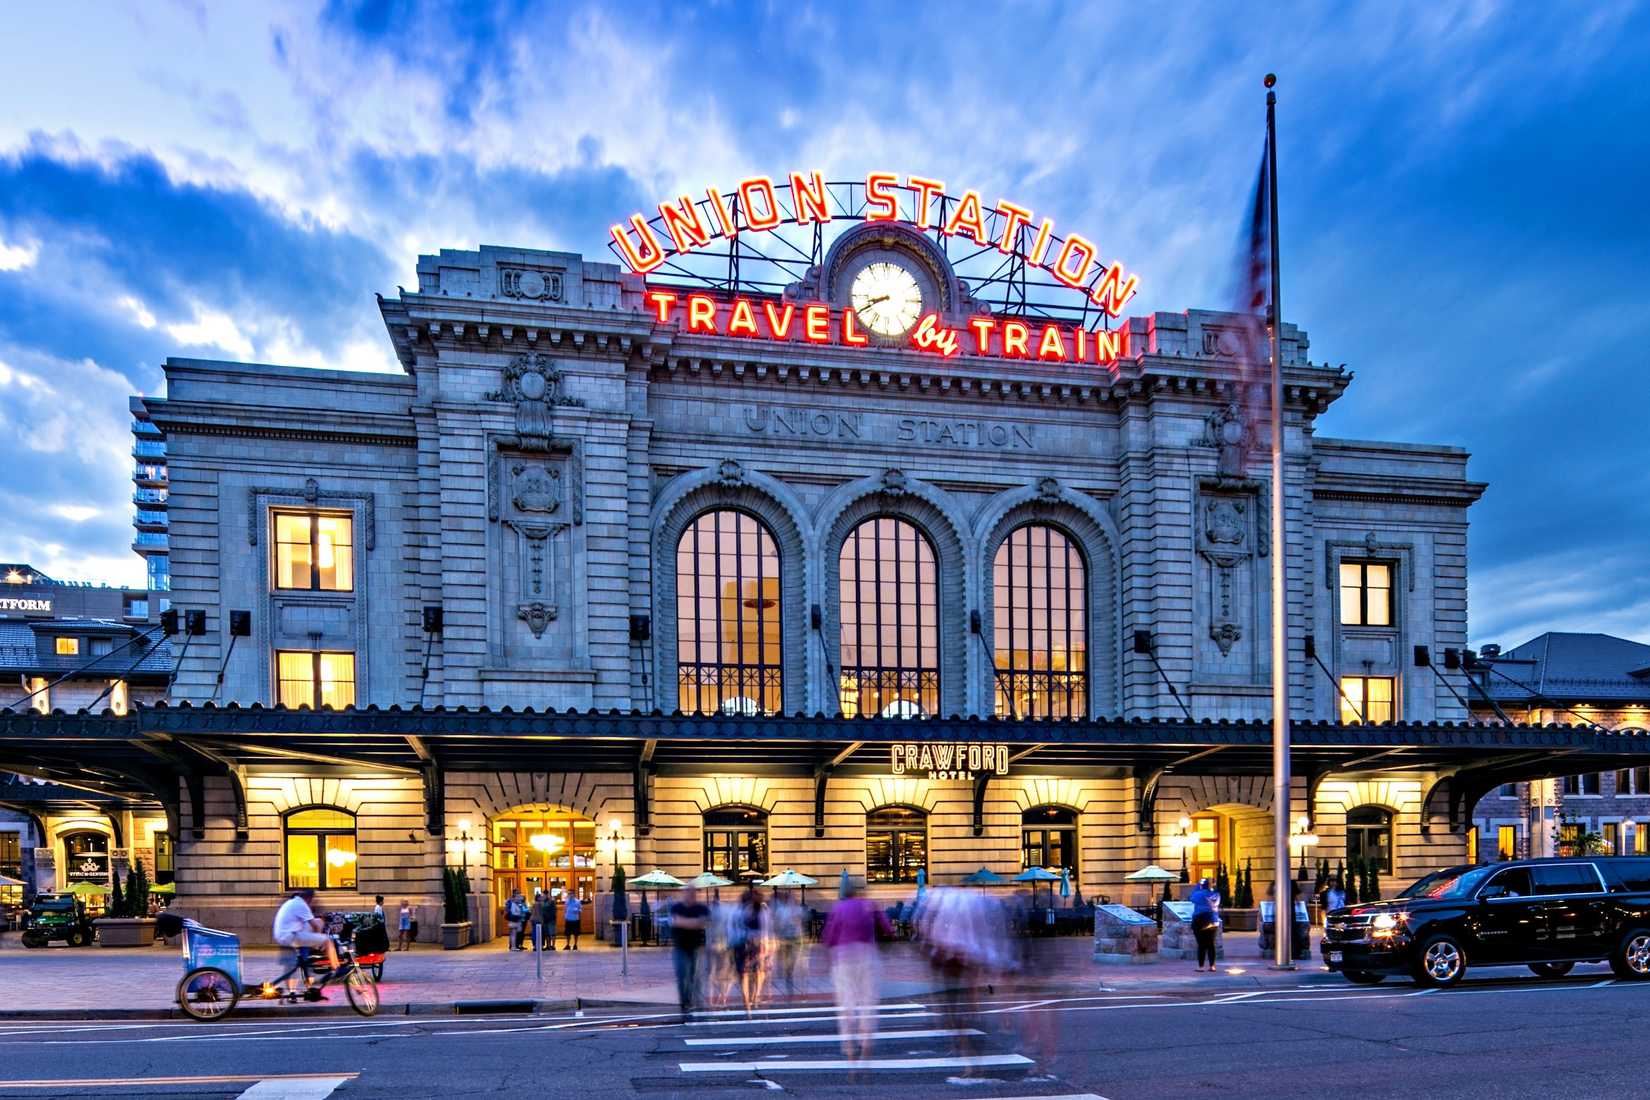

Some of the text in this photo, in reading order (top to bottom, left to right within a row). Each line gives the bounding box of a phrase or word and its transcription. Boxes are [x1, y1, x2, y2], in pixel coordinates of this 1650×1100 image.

[609, 169, 1139, 318] UNION STATION
[648, 291, 1122, 364] TRAVEL by TRAIN
[744, 407, 1034, 448] UNION STATION
[0, 598, 51, 611] TFORM
[891, 744, 1009, 775] CRAWFORD
[928, 771, 975, 780] HOTEL
